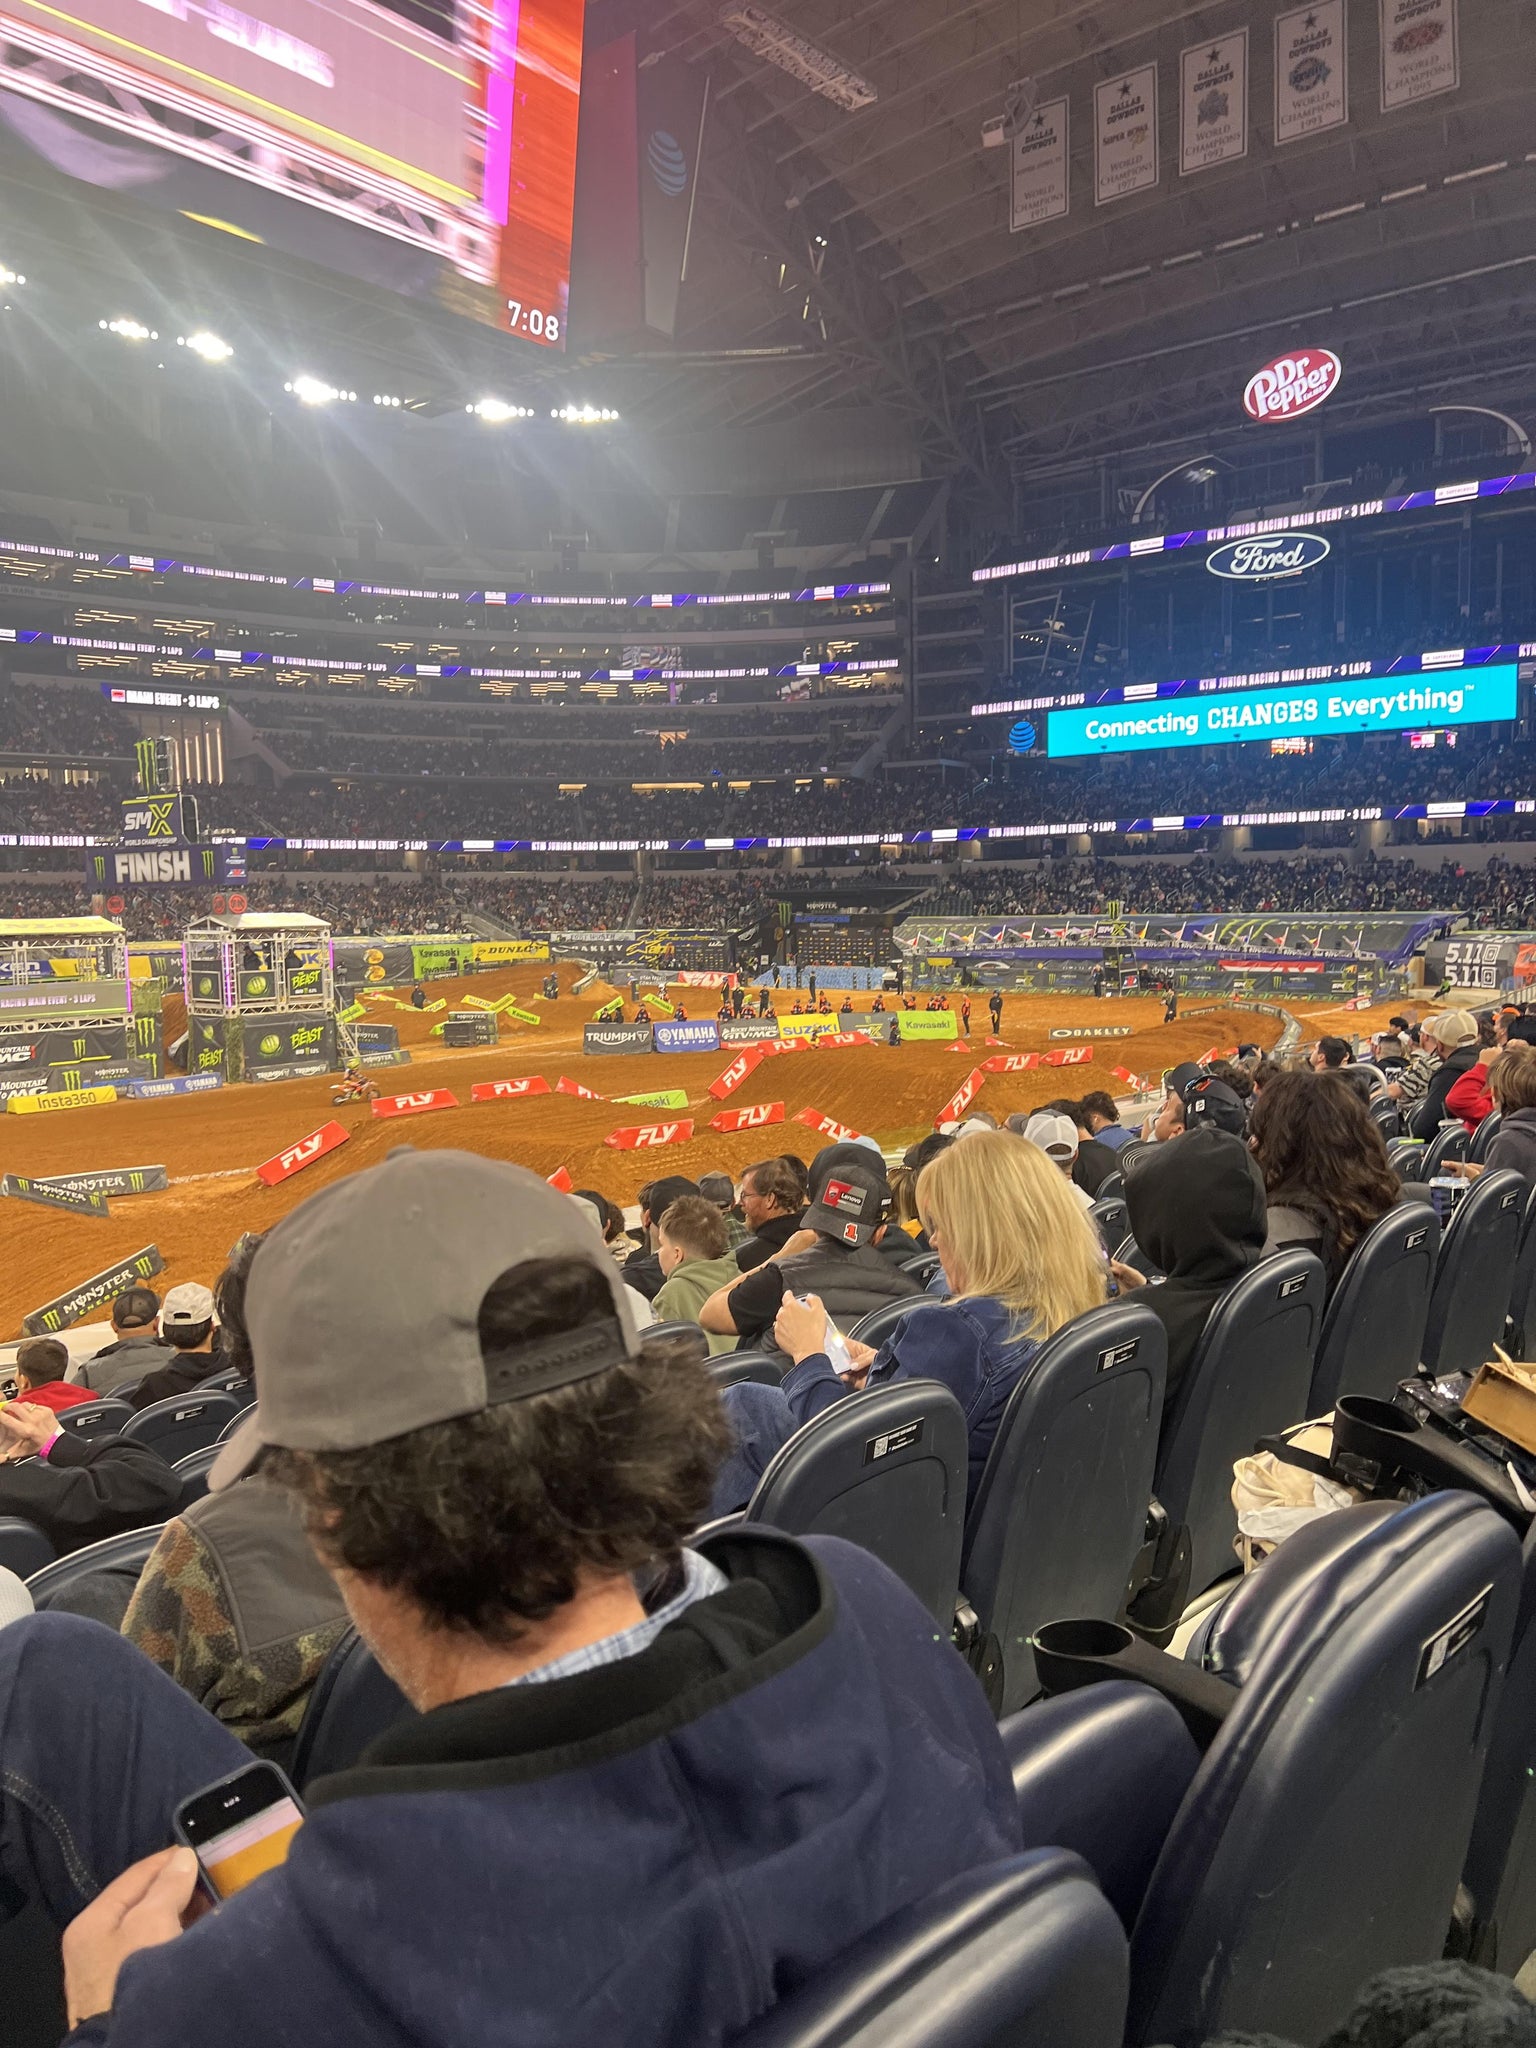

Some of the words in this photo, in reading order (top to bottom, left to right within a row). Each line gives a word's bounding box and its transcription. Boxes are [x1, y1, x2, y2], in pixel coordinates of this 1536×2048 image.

[1293, 28, 1328, 48] DALLAS
[1289, 37, 1332, 59] COWBOYS
[1194, 71, 1234, 92] COWBOYS
[1198, 63, 1230, 81] DALLAS
[1110, 96, 1140, 114] DALLAS
[1292, 91, 1330, 109] WORLD
[1107, 104, 1144, 124] COWBOYS
[1281, 100, 1341, 125] CHAMPIONS
[1025, 128, 1054, 144] DALLAS
[1196, 124, 1231, 142] WORLD
[1022, 136, 1057, 154] COWBOYS
[1185, 133, 1241, 157] CHAMPIONS
[1110, 154, 1143, 171] WORLD
[1100, 162, 1153, 186] CHAMPIONS
[1024, 184, 1055, 200] WORLD
[508, 300, 559, 341] 7:08
[1274, 357, 1310, 390] Dr
[1249, 362, 1333, 418] Pepper
[1207, 528, 1224, 541] KTM
[1226, 522, 1255, 538] JUNIOR
[1257, 517, 1288, 533] RACING
[1291, 512, 1314, 528] MAIN
[1316, 507, 1342, 523] EVENT
[1360, 500, 1382, 515] LAPS
[992, 564, 1016, 579] RACING
[1018, 559, 1036, 574] MAIN
[1038, 556, 1058, 571] EVENT
[1072, 550, 1090, 564] LAPS
[1230, 539, 1304, 574] Ford
[53, 636, 67, 644] KTM
[69, 637, 92, 647] JUNIOR
[93, 640, 117, 650] RACING
[119, 642, 135, 651] MAIN
[137, 644, 155, 652] EVENT
[167, 647, 183, 655] LAPS
[1199, 678, 1216, 690] KTM
[1218, 674, 1247, 688] JUNIOR
[1249, 670, 1279, 686] RACING
[1282, 668, 1304, 682] MAIN
[1306, 665, 1332, 680] EVENT
[1349, 661, 1372, 674] LAPS
[127, 690, 154, 704] MAIN
[155, 692, 181, 706] EVENT
[188, 694, 195, 707] 3
[196, 695, 220, 709] LAPS
[1086, 712, 1198, 739] Connecting
[1208, 698, 1318, 730] CHANGES
[124, 802, 174, 837] SMX
[1223, 815, 1239, 825] KTM
[1240, 813, 1267, 825] JUNIOR
[1268, 812, 1296, 824] RACING
[1299, 811, 1320, 822] MAIN
[1321, 809, 1345, 821] EVENT
[1360, 808, 1381, 819] LAPS
[19, 836, 50, 846] JUNIOR
[52, 836, 84, 846] RACING
[125, 838, 140, 847] WORLD
[141, 837, 177, 846] CHAMPIONSHIP
[286, 839, 302, 848] KTM
[304, 839, 329, 849] JUNIOR
[330, 840, 356, 849] RACING
[358, 840, 376, 850] MAIN
[378, 840, 398, 850] EVENT
[411, 841, 428, 850] LAPS
[532, 841, 546, 850] KTM
[548, 841, 572, 850] JUNIOR
[573, 841, 598, 850] RACING
[600, 841, 617, 850] MAIN
[619, 841, 639, 850] EVENT
[652, 841, 669, 850] LAPS
[114, 850, 192, 884] FINISH
[1098, 923, 1127, 936] SMX
[419, 948, 460, 957] Kawasaki
[1445, 943, 1483, 964] 5.11
[291, 970, 320, 988] BEAST
[1444, 965, 1481, 987] 5.11
[28, 996, 46, 1006] MAIN
[48, 995, 67, 1005] EVENT
[80, 994, 96, 1003] LAPS
[670, 1026, 716, 1040] YAMAHA
[906, 1021, 950, 1029] Kawasaki
[1074, 1027, 1130, 1036] OAKLEY
[290, 1026, 324, 1048] BEAST
[586, 1032, 636, 1045] TRIUMPH
[773, 1039, 796, 1050] FLY
[835, 1033, 855, 1043] FLY
[198, 1049, 223, 1068] BEAST
[1004, 1056, 1030, 1071] FLY
[1062, 1048, 1086, 1064] FLY
[722, 1057, 747, 1088] FLY
[0, 1078, 47, 1090] MOUNTAIN
[493, 1080, 530, 1094] FLY
[38, 1092, 96, 1109] Insta360
[395, 1093, 434, 1109] FLY
[952, 1080, 973, 1117] FLY
[737, 1104, 772, 1127] FLY
[635, 1124, 678, 1147] FLY
[280, 1134, 323, 1170] FLY
[33, 1182, 86, 1202] MONSTER
[841, 1192, 861, 1204] Lenovo
[844, 1222, 858, 1242] 1
[63, 1269, 134, 1314] MONSTER
